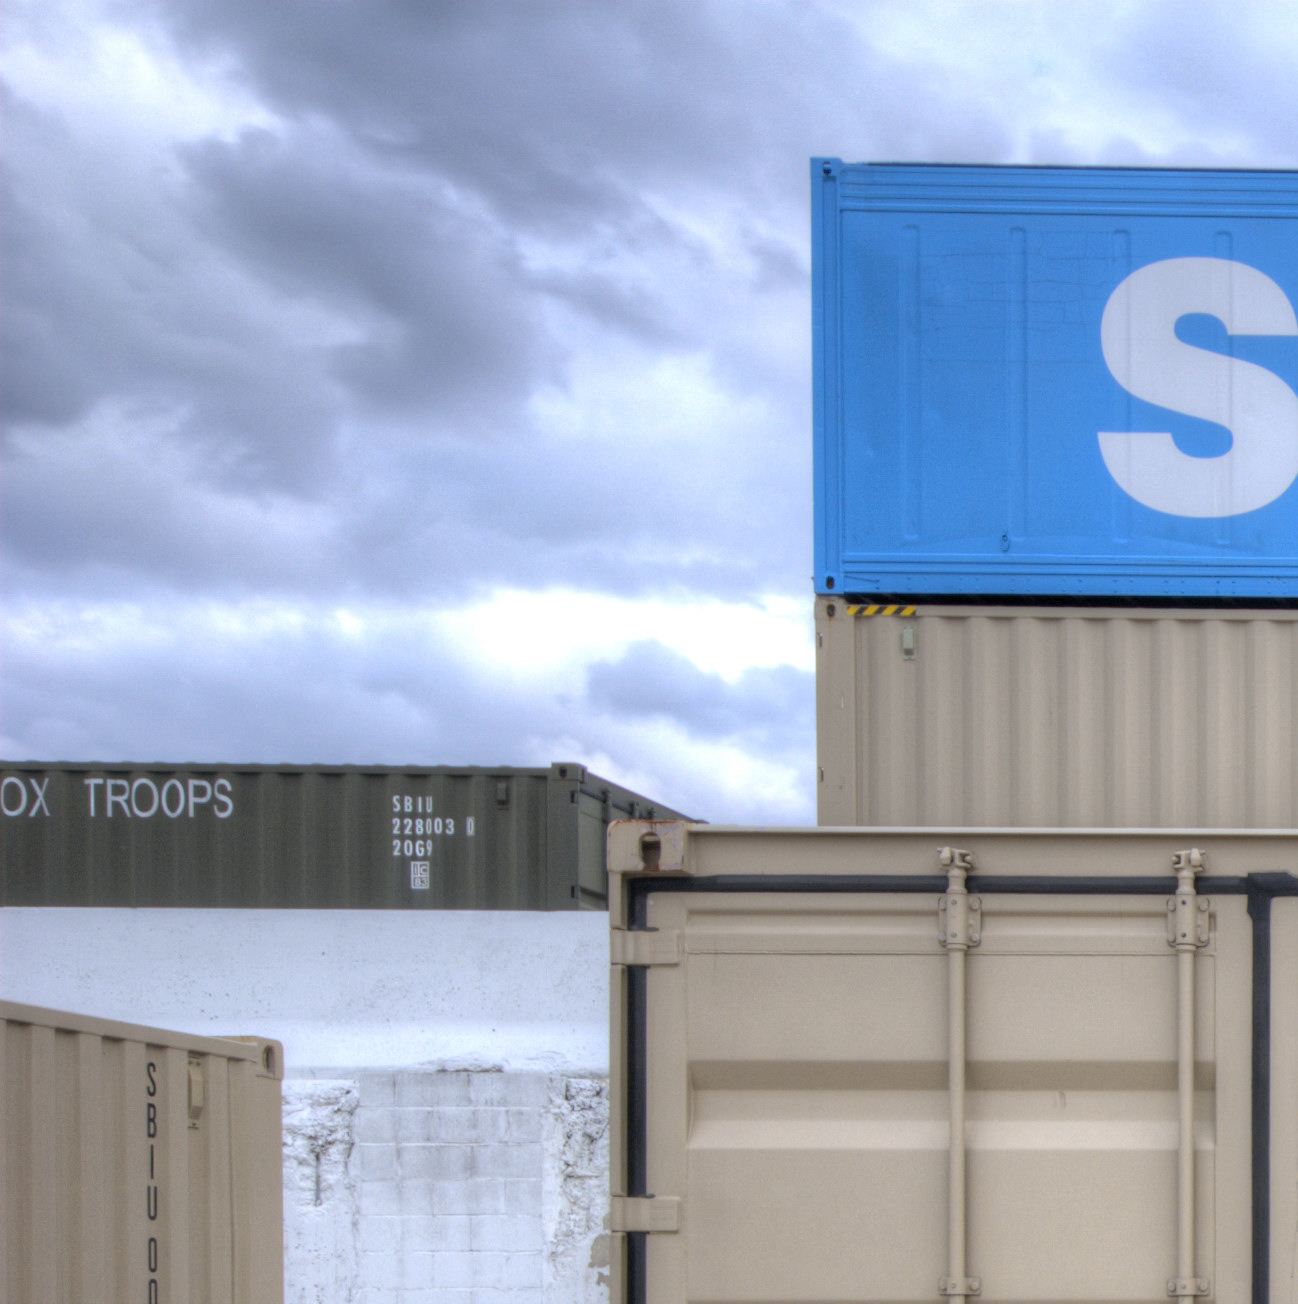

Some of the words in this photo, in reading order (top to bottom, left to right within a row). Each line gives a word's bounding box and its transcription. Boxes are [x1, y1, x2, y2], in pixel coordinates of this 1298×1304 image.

[1, 777, 50, 817] OX
[84, 778, 234, 818] TROOPS
[392, 795, 433, 813] SBIU
[392, 818, 455, 835] 228003
[392, 839, 433, 857] 20G9
[146, 1062, 157, 1221] SBIU
